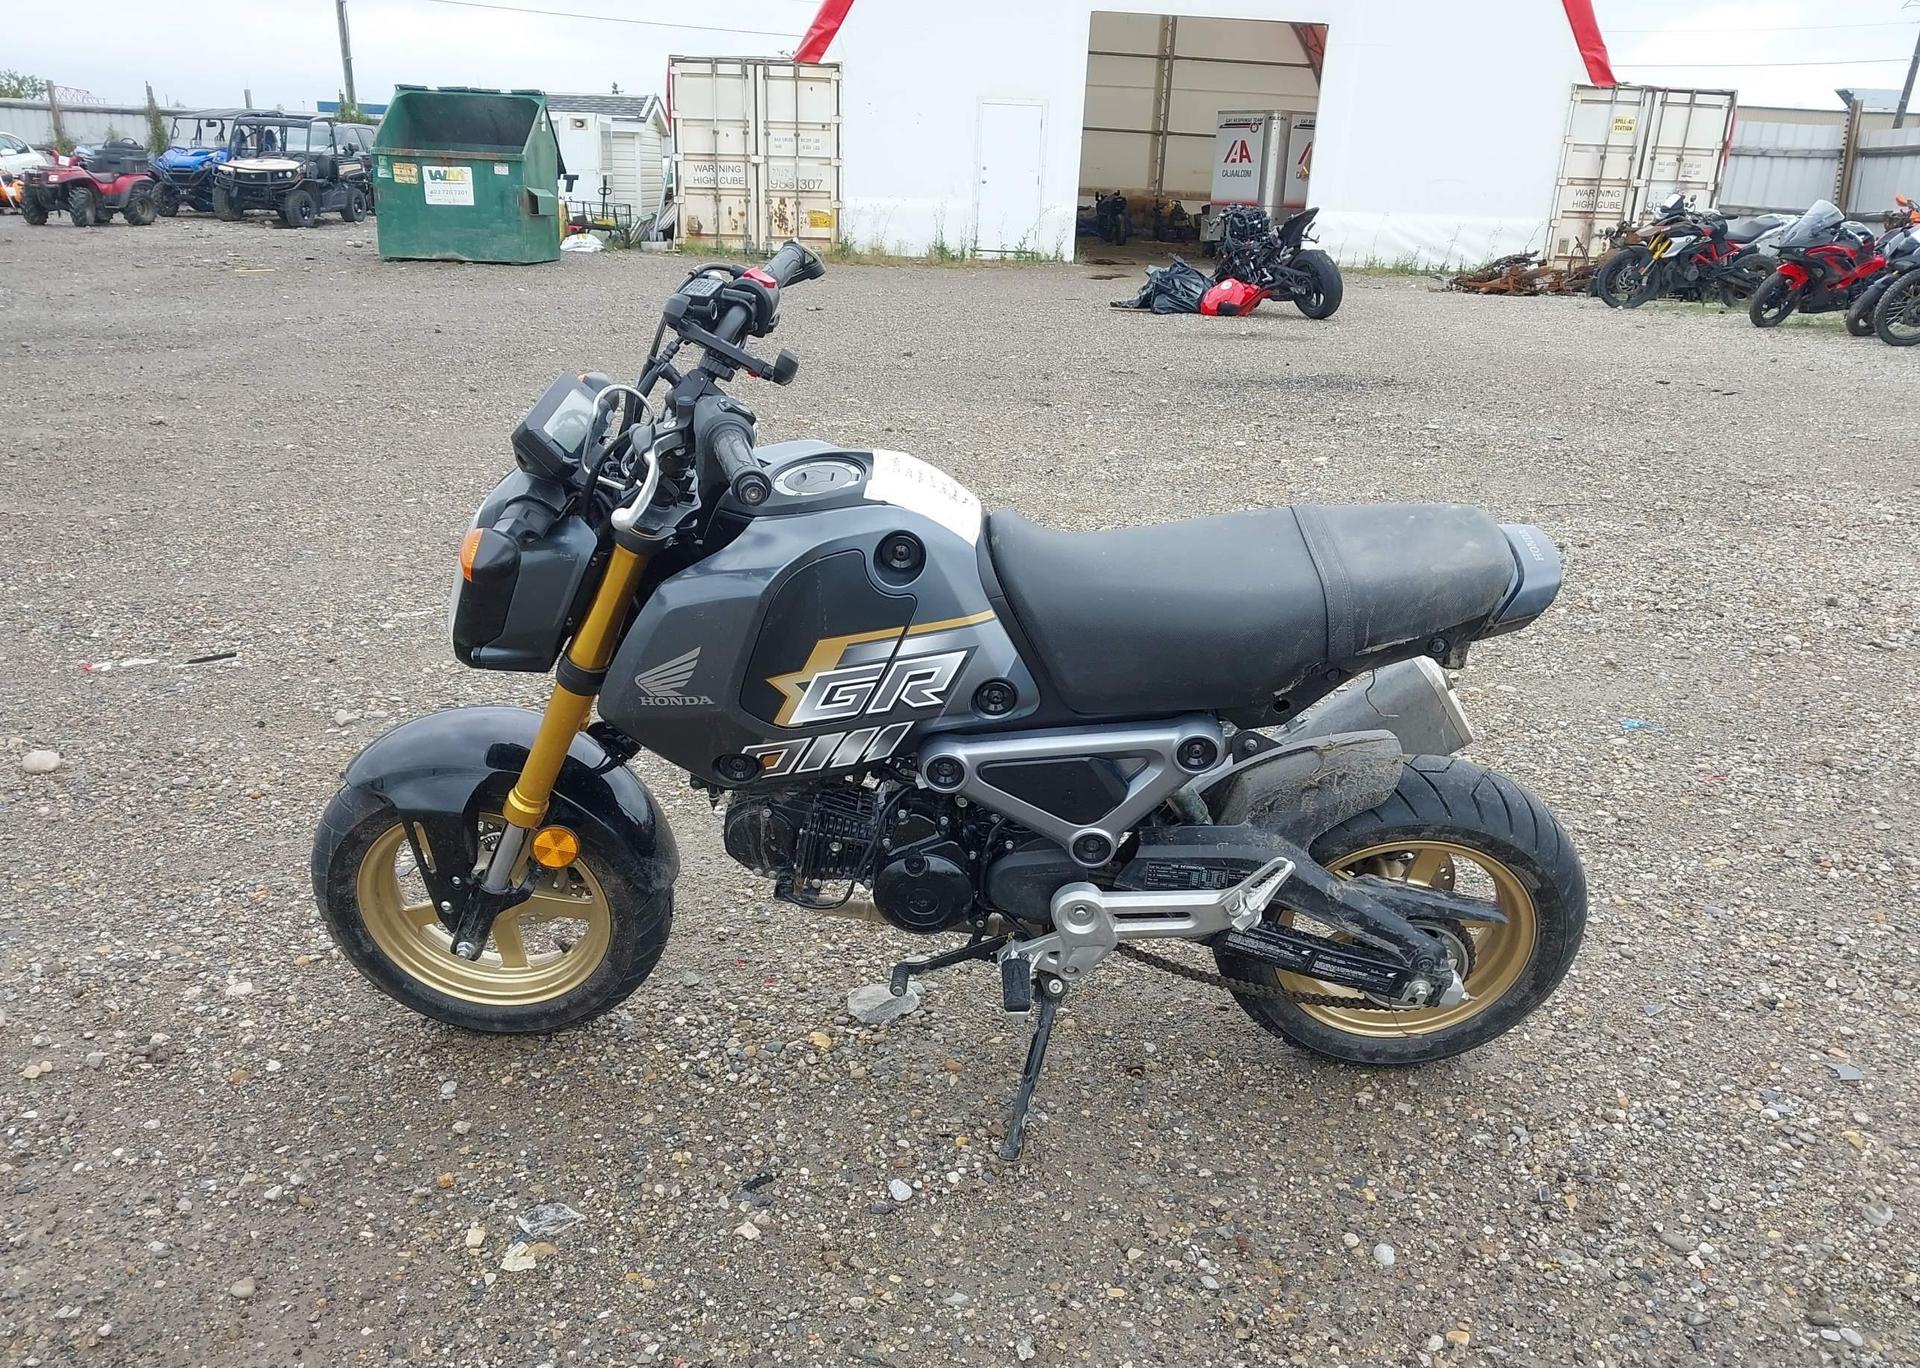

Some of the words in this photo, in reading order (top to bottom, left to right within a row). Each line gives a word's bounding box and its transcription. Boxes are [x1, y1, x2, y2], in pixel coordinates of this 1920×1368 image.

[693, 164, 742, 173] WARNING
[693, 176, 716, 185] HIGH
[719, 176, 745, 185] CUBE
[1575, 189, 1621, 198] WARNING
[1572, 200, 1594, 209] HIGH
[1597, 201, 1621, 210] CUBE
[640, 695, 714, 706] HONDA
